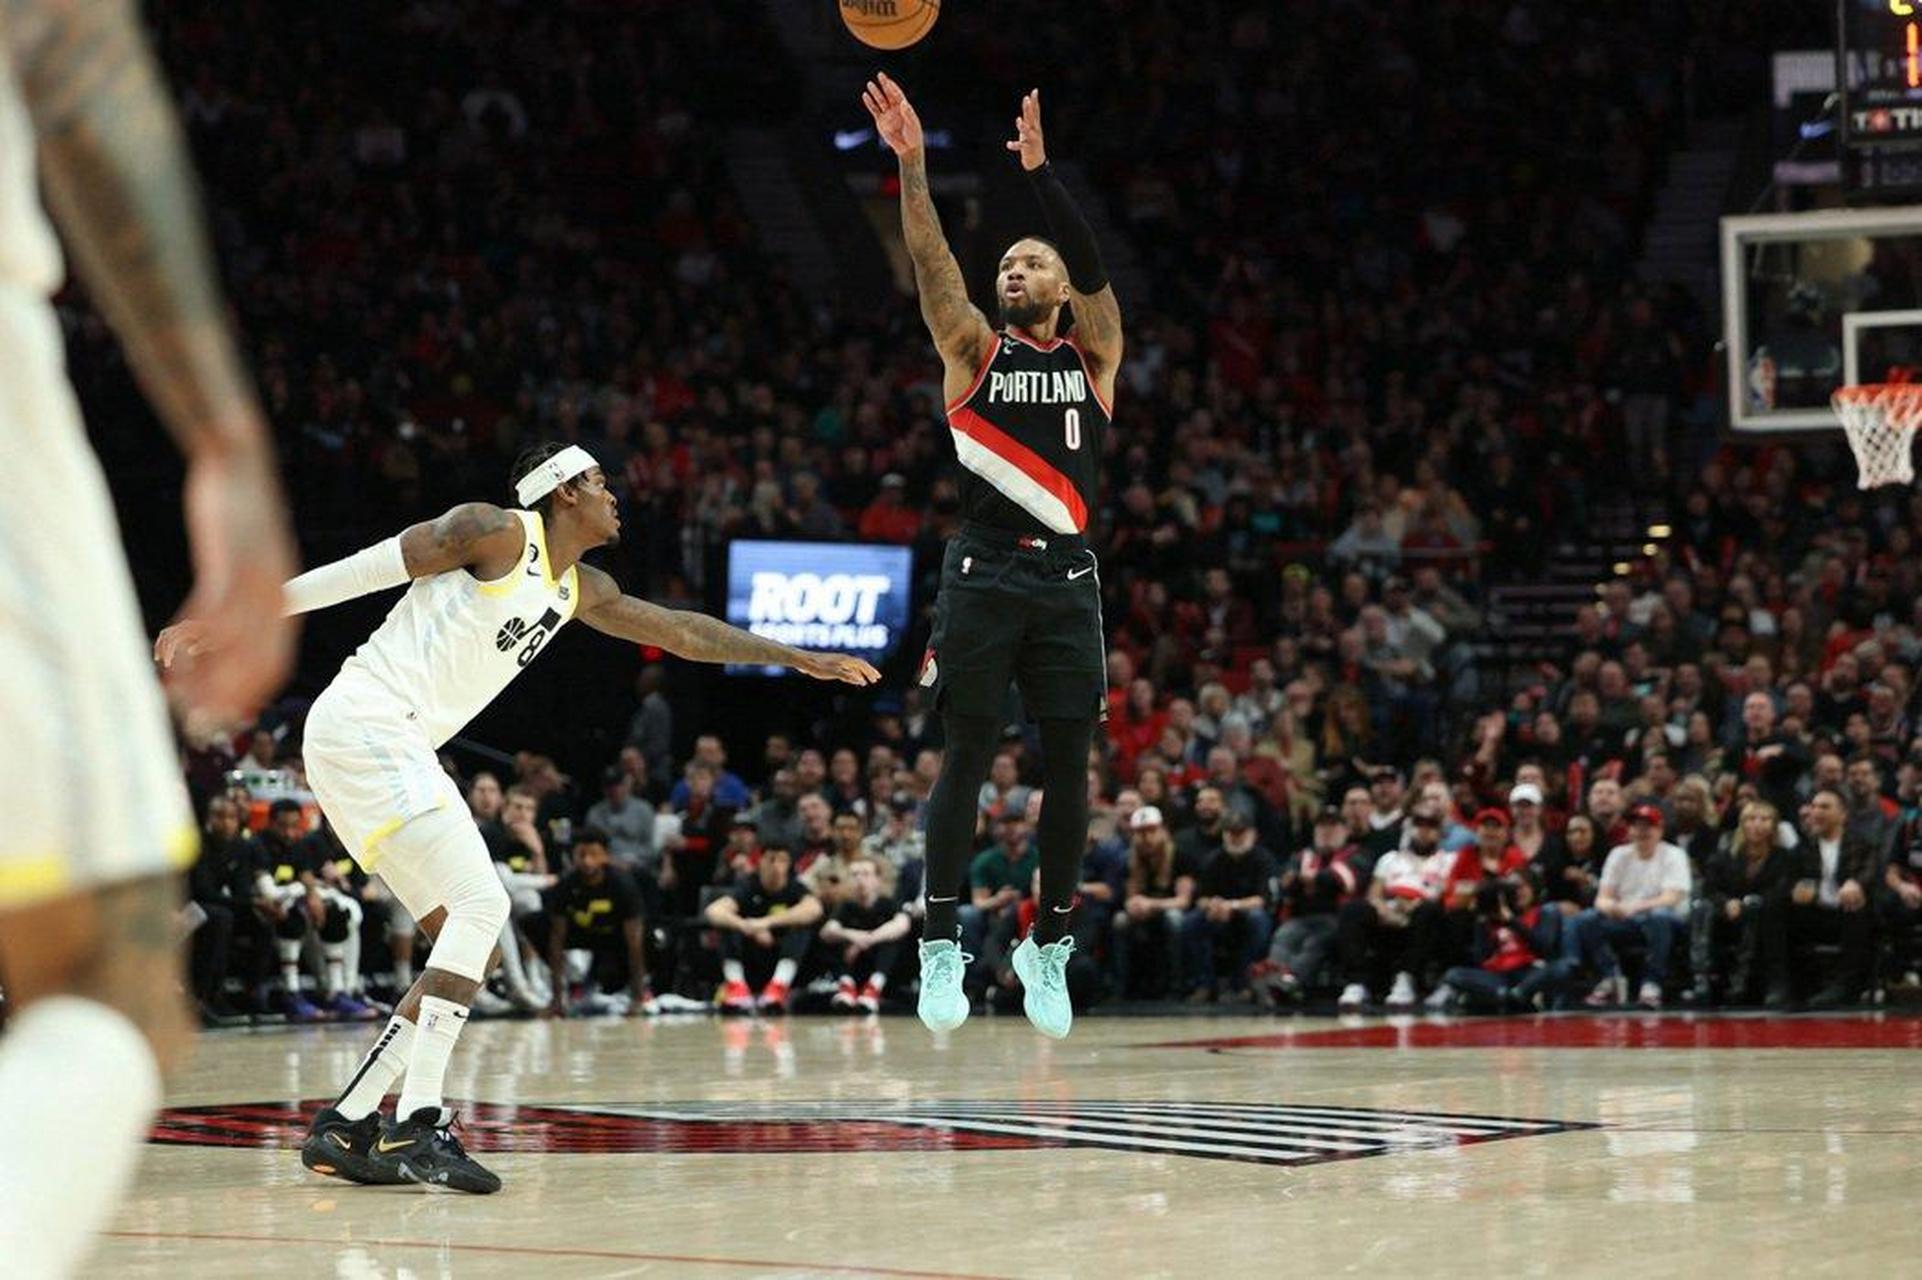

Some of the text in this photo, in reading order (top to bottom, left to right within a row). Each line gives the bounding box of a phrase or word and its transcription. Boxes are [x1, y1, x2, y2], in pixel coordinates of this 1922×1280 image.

[988, 369, 1087, 404] PORTLAND
[1064, 407, 1081, 450] 0
[748, 571, 891, 625] ROOT
[516, 628, 546, 668] 8
